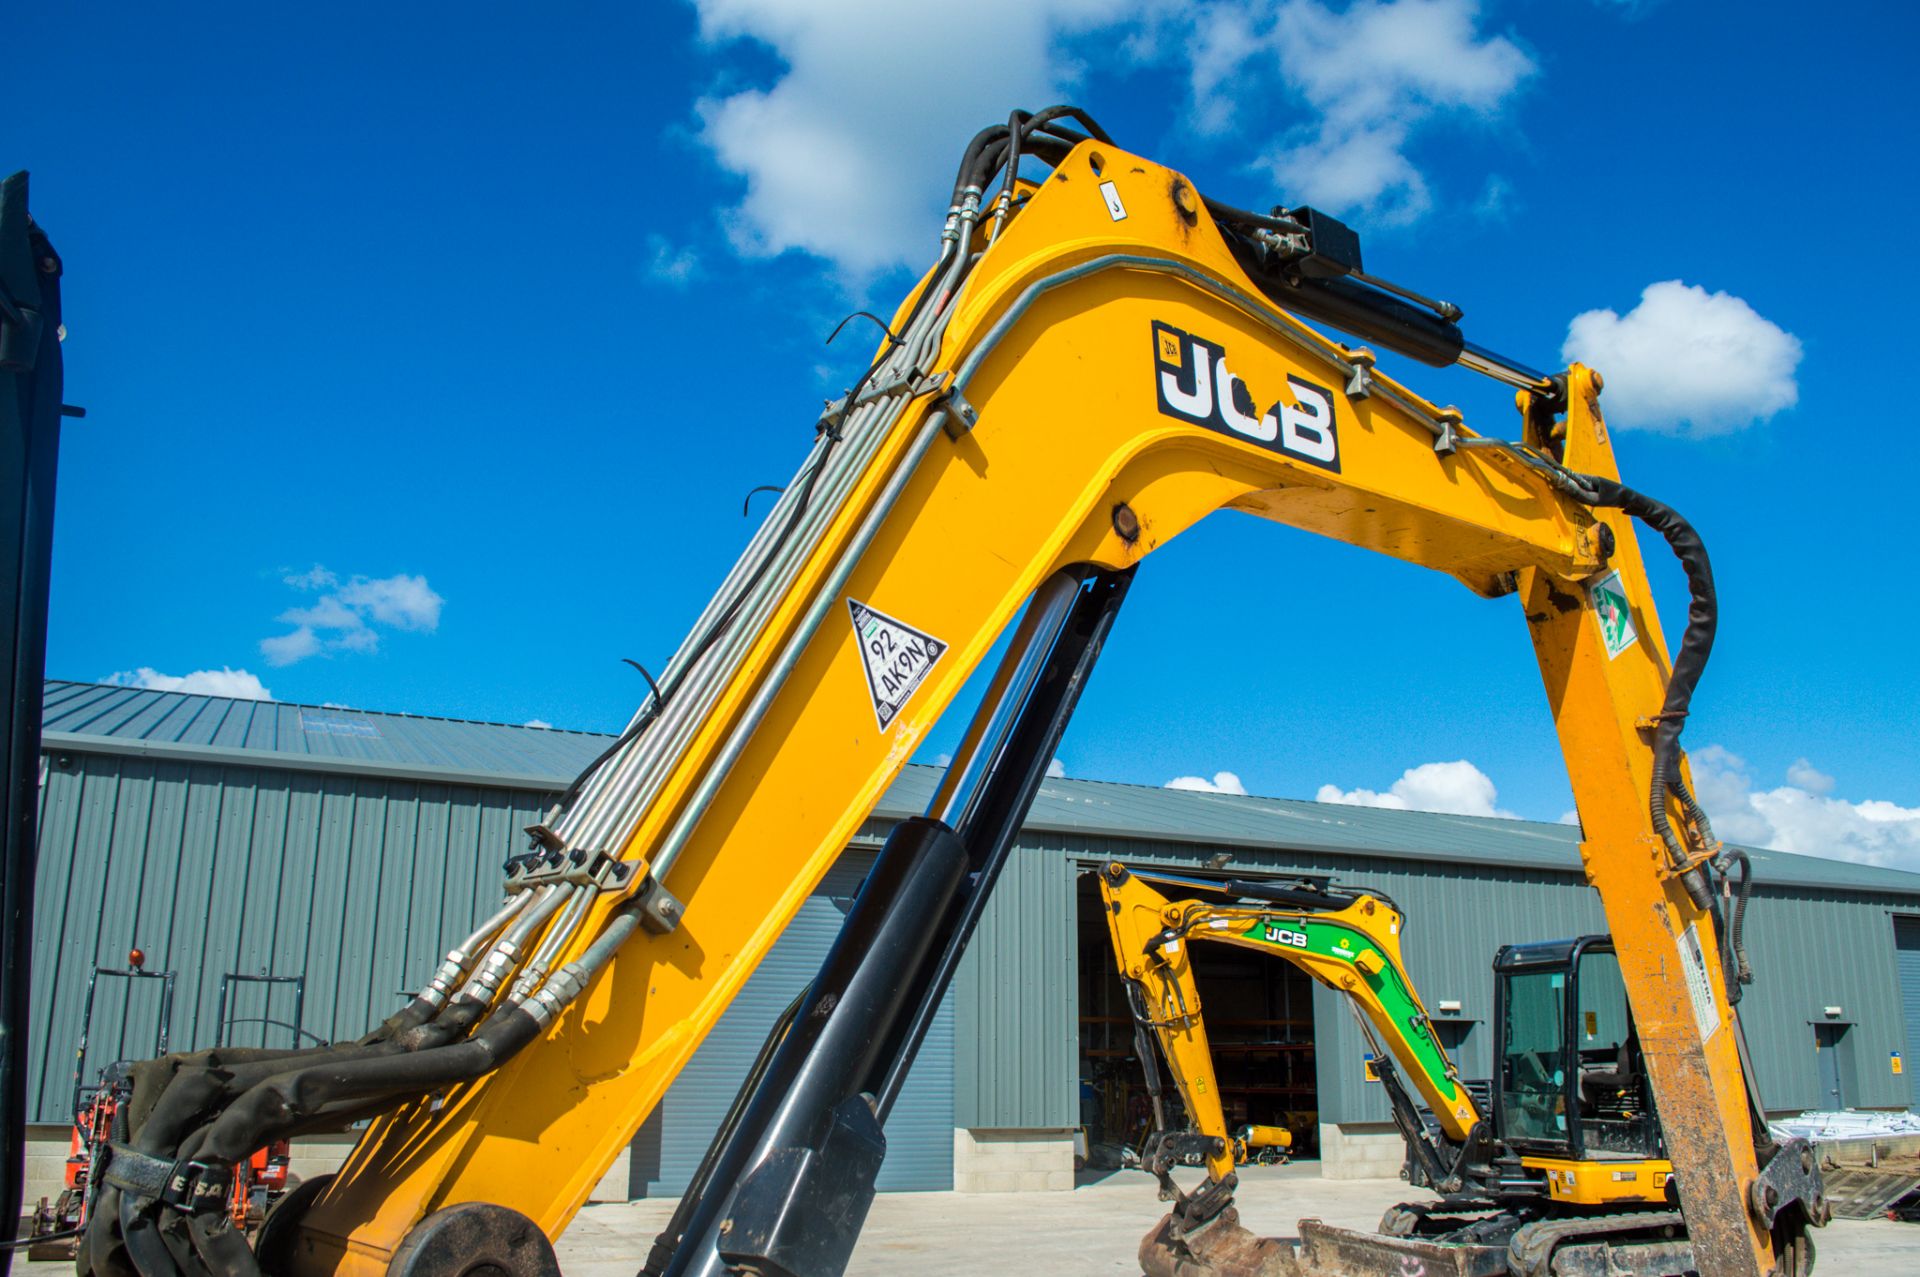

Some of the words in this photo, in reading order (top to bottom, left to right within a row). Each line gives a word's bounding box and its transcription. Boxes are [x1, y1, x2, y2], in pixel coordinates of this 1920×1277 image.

[1160, 342, 1336, 463] JCB
[870, 628, 897, 661] 92
[881, 638, 925, 697] AK9N
[1265, 927, 1308, 948] JCB
